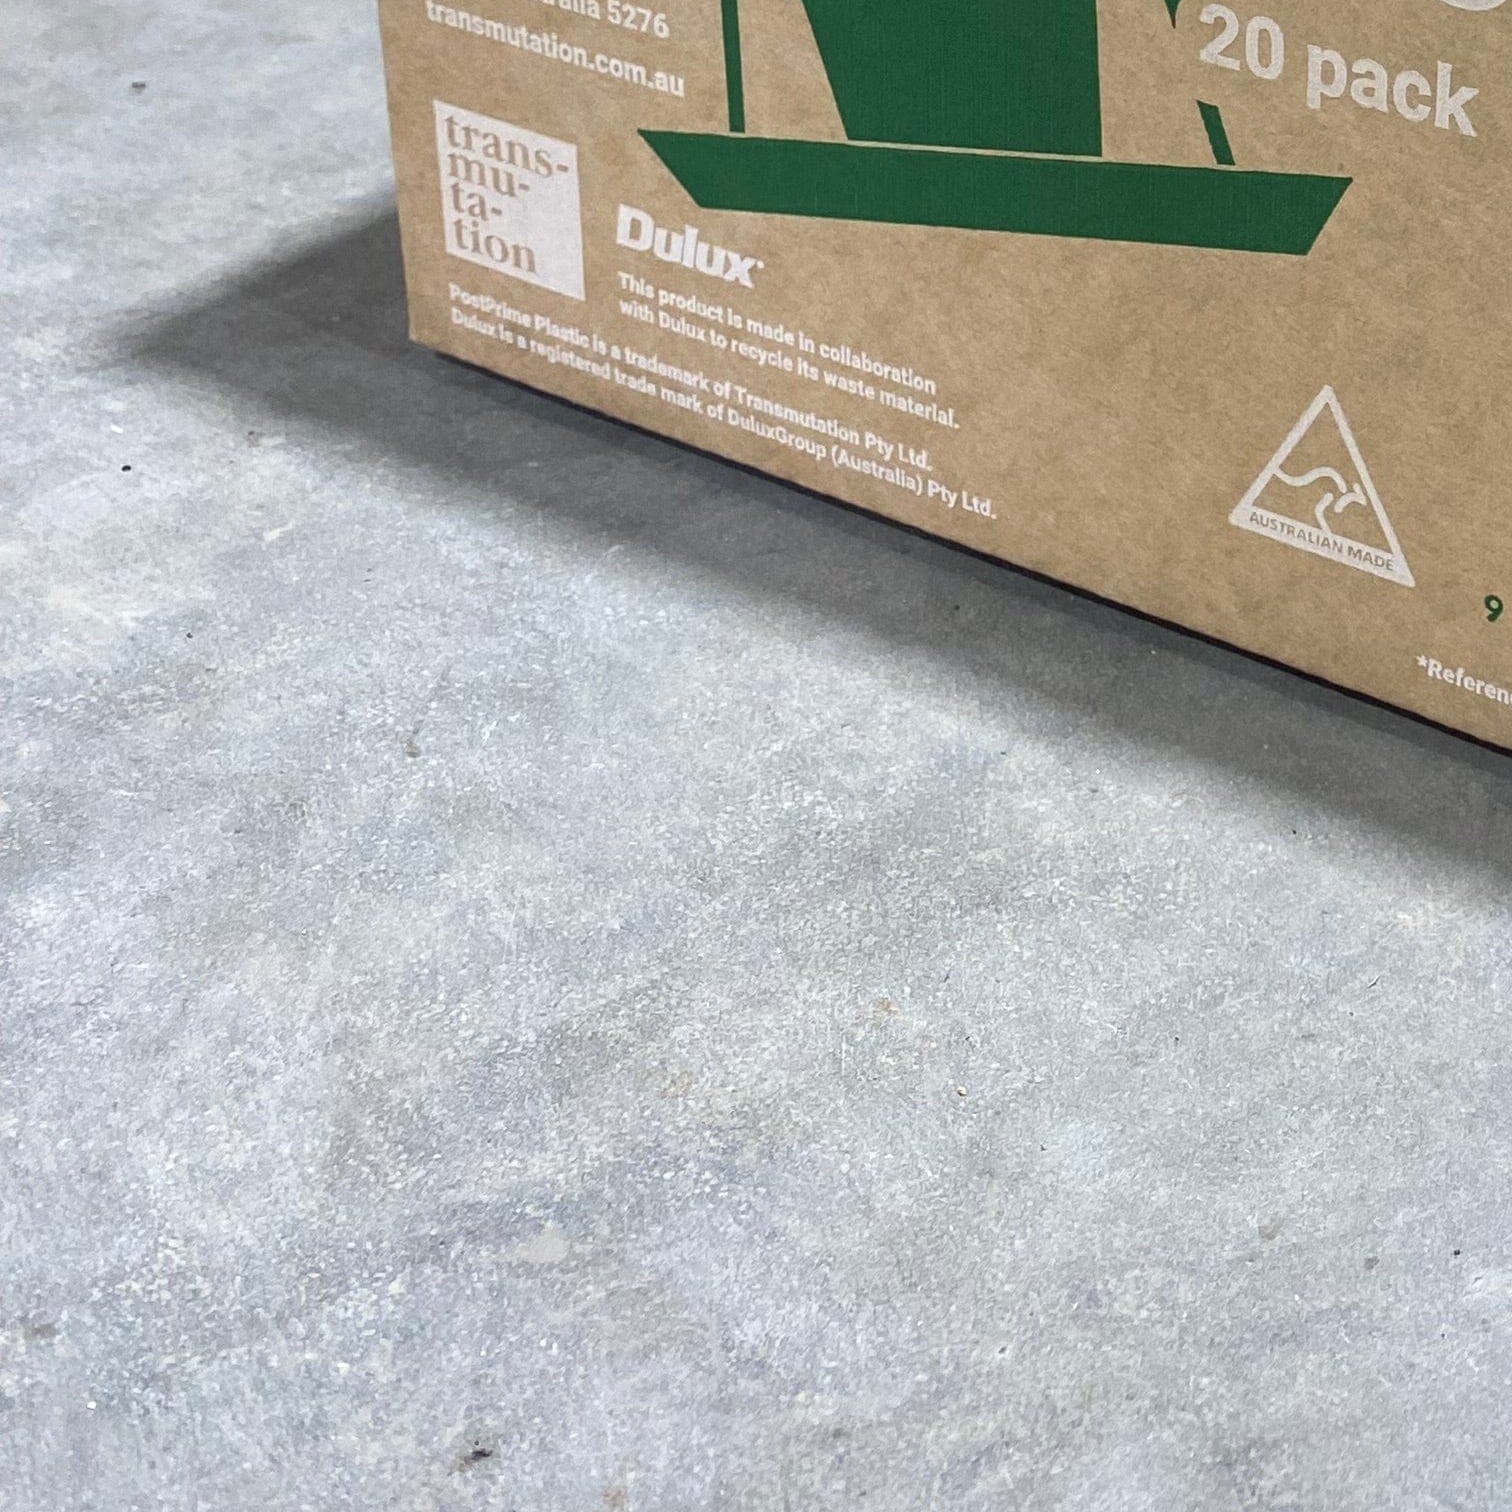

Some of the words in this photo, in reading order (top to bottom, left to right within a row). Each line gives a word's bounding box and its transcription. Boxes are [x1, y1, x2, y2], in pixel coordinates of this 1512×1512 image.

[607, 0, 671, 40] 5276
[1199, 3, 1286, 80] 20
[1305, 42, 1478, 138] pack
[445, 115, 570, 178] trans-
[449, 153, 531, 197] mu-
[451, 181, 502, 222] ta-
[453, 217, 537, 274] tion
[617, 203, 757, 289] Dulux
[618, 271, 655, 299] This
[658, 287, 723, 322] product
[727, 308, 743, 329] is
[747, 315, 795, 346] made
[799, 329, 814, 354] in
[819, 342, 937, 395] collaboration
[619, 299, 655, 325] with
[659, 311, 707, 343] Dulux
[710, 330, 727, 351] to
[731, 340, 793, 372] recycle
[797, 356, 819, 381] its
[823, 368, 875, 401] waste
[879, 388, 960, 430] material.
[449, 283, 531, 327] PostPrime
[534, 313, 590, 348] Plastic
[592, 334, 607, 355] is
[610, 344, 621, 360] a
[624, 347, 709, 392] trademark
[713, 380, 731, 401] of
[733, 387, 860, 446] Transmutation
[865, 432, 894, 462] Pty
[898, 445, 933, 472] Ltd.
[451, 307, 496, 339] Dulux
[499, 324, 513, 344] is
[517, 335, 528, 350] a
[530, 338, 611, 380] registered
[614, 368, 657, 396] trade
[660, 386, 703, 415] mark
[707, 399, 727, 421] of
[728, 408, 827, 461] DuluxGroup
[831, 444, 923, 496] (Australia)
[927, 478, 958, 508] Pty
[962, 490, 997, 521] Ltd.
[1249, 511, 1343, 554] AUSTRALIAN
[1348, 546, 1394, 571] MADE
